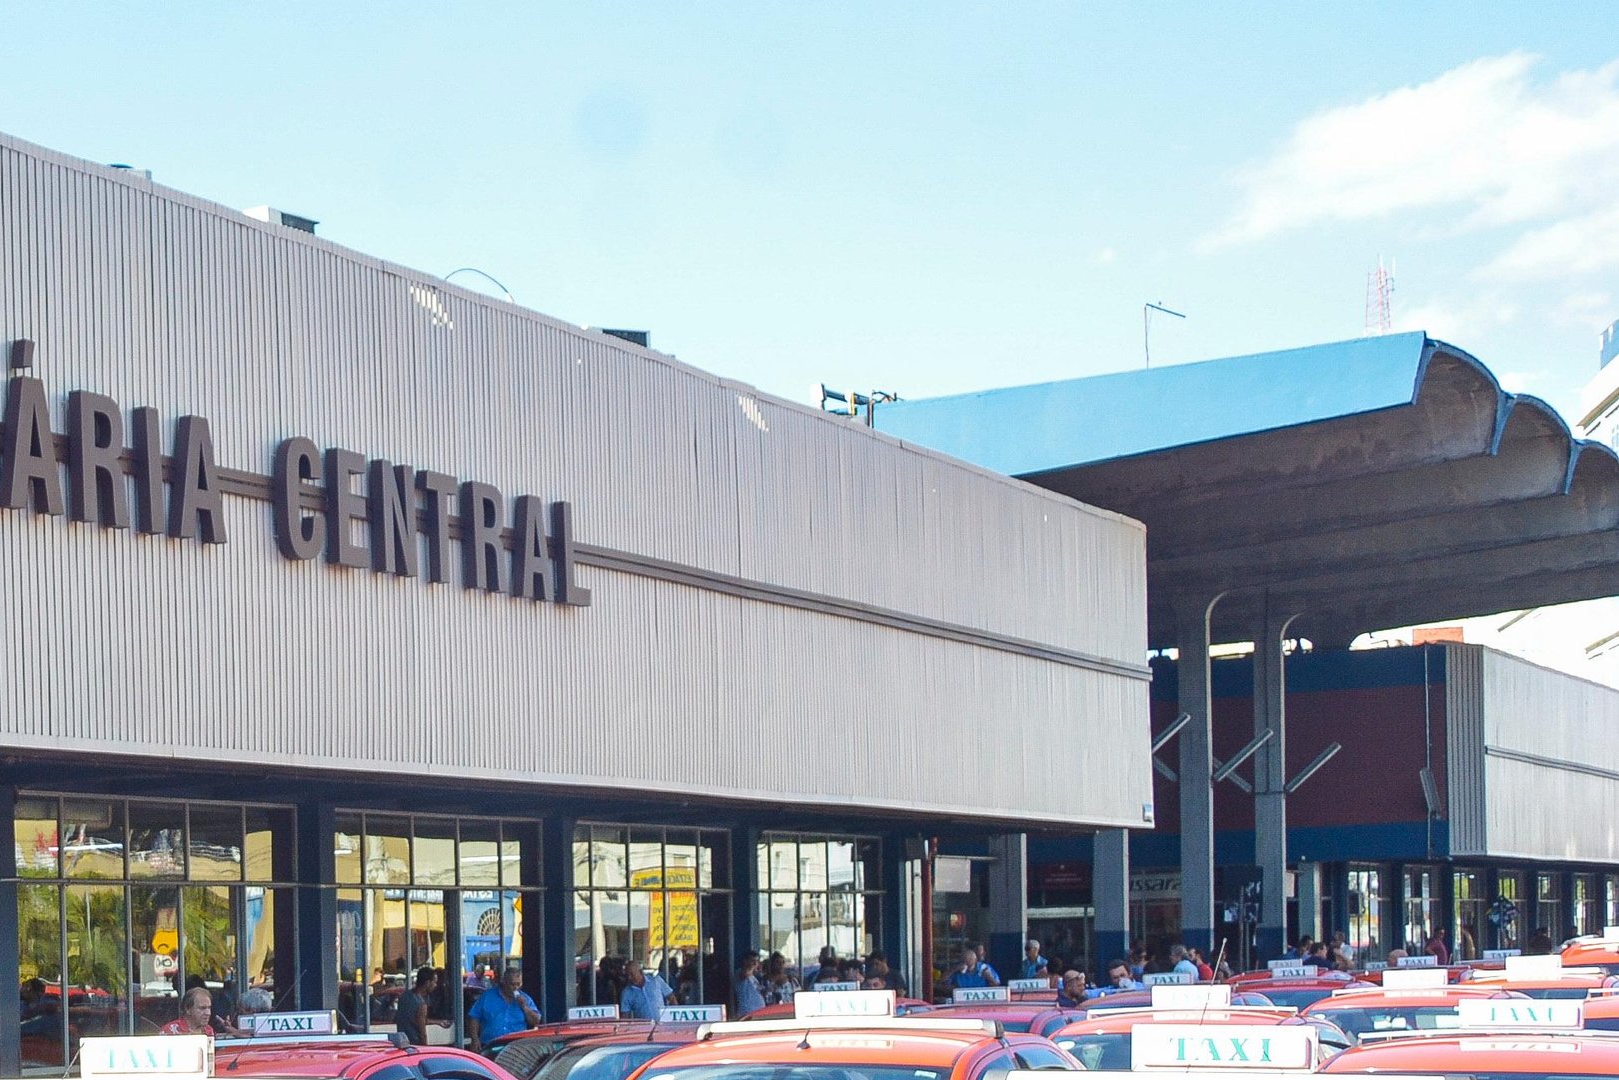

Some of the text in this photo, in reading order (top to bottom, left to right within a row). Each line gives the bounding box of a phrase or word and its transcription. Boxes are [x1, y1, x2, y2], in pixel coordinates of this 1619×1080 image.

[275, 435, 592, 607] CENTRAL
[1281, 969, 1306, 977] TAXI
[1152, 975, 1181, 984] TAXI
[1015, 981, 1040, 989] TAXI
[964, 991, 997, 1001] TAXI
[575, 1008, 606, 1018] TAXI
[669, 1010, 708, 1021] TAXI
[268, 1017, 316, 1031] TAXI
[1169, 1037, 1272, 1062] TAXI
[108, 1048, 173, 1069] TAXI
